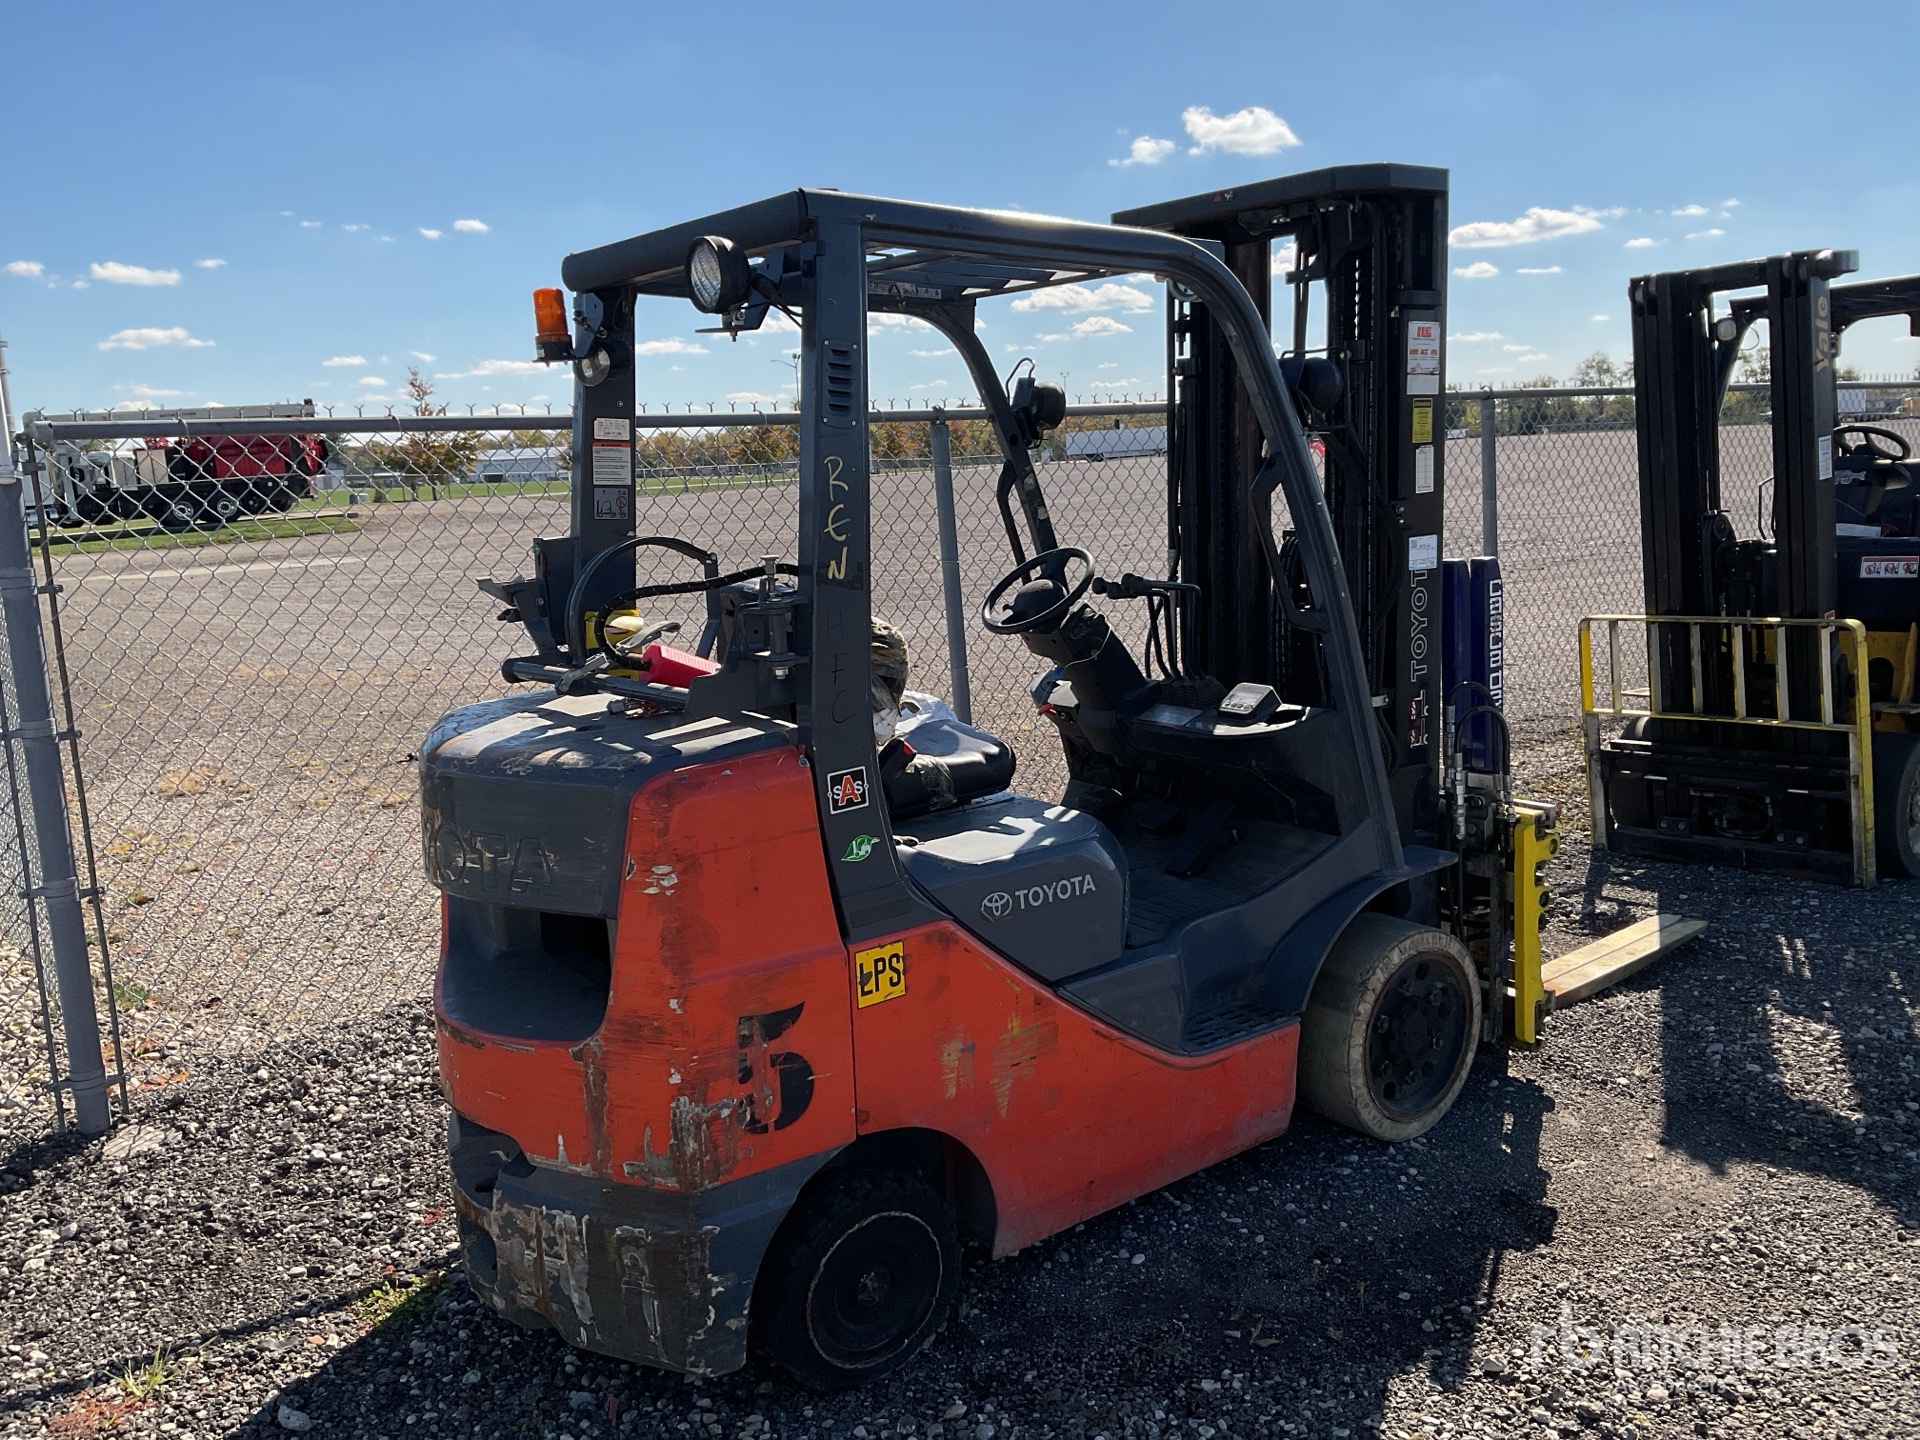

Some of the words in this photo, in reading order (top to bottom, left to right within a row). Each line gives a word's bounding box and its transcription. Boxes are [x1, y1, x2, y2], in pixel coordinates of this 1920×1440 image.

[1814, 296, 1830, 373] Yale
[824, 455, 852, 581] REN
[1410, 569, 1428, 683] TOYOT
[1014, 873, 1097, 911] TOYOTA
[857, 952, 903, 998] LPS
[737, 1001, 815, 1135] 5
